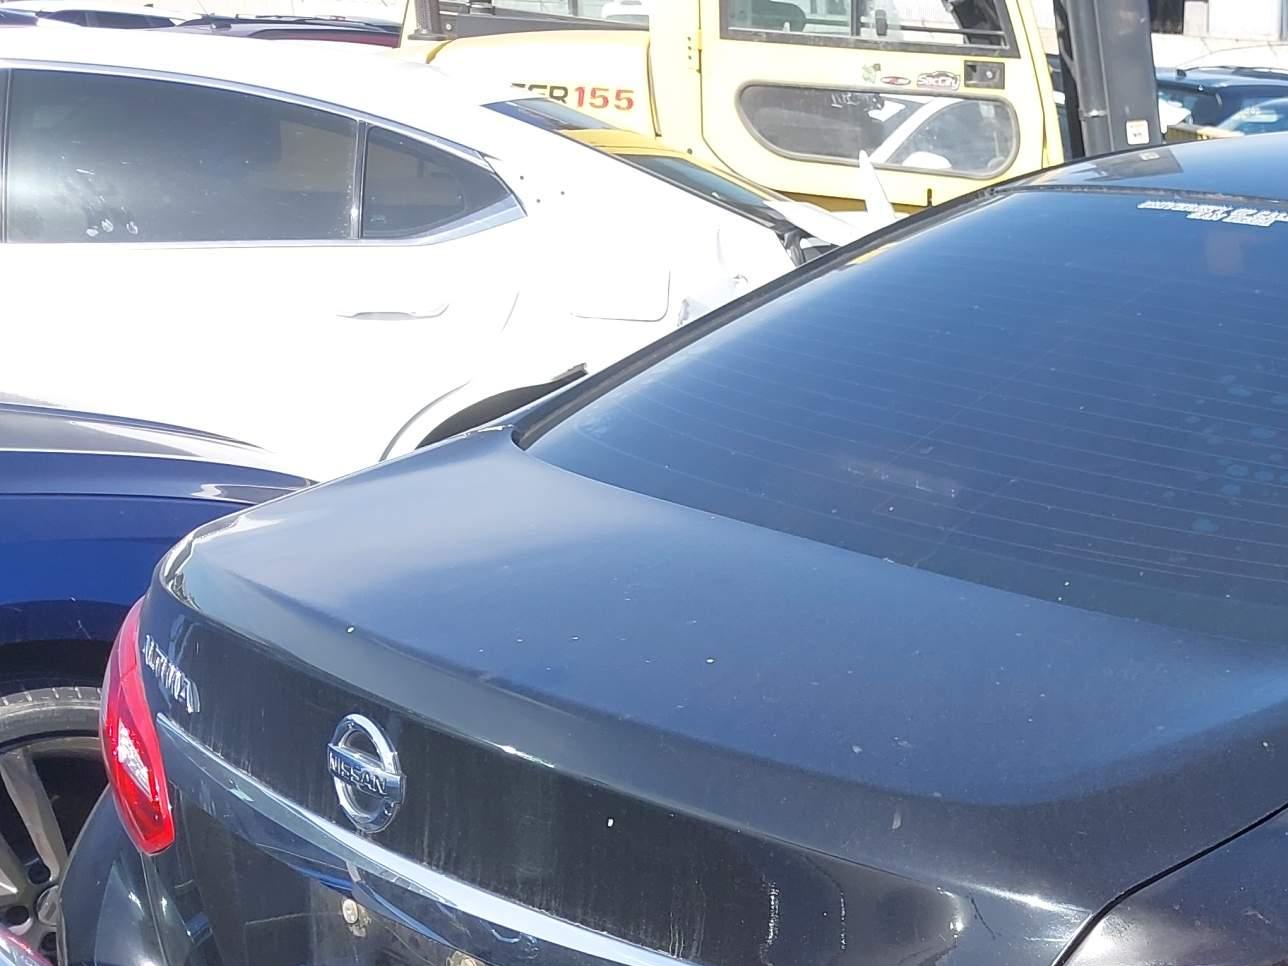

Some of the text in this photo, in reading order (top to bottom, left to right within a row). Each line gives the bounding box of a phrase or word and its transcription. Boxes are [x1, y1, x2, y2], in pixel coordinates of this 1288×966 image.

[575, 86, 634, 110] 155
[143, 635, 201, 713] ALTIMA
[329, 751, 387, 795] NISSAN
